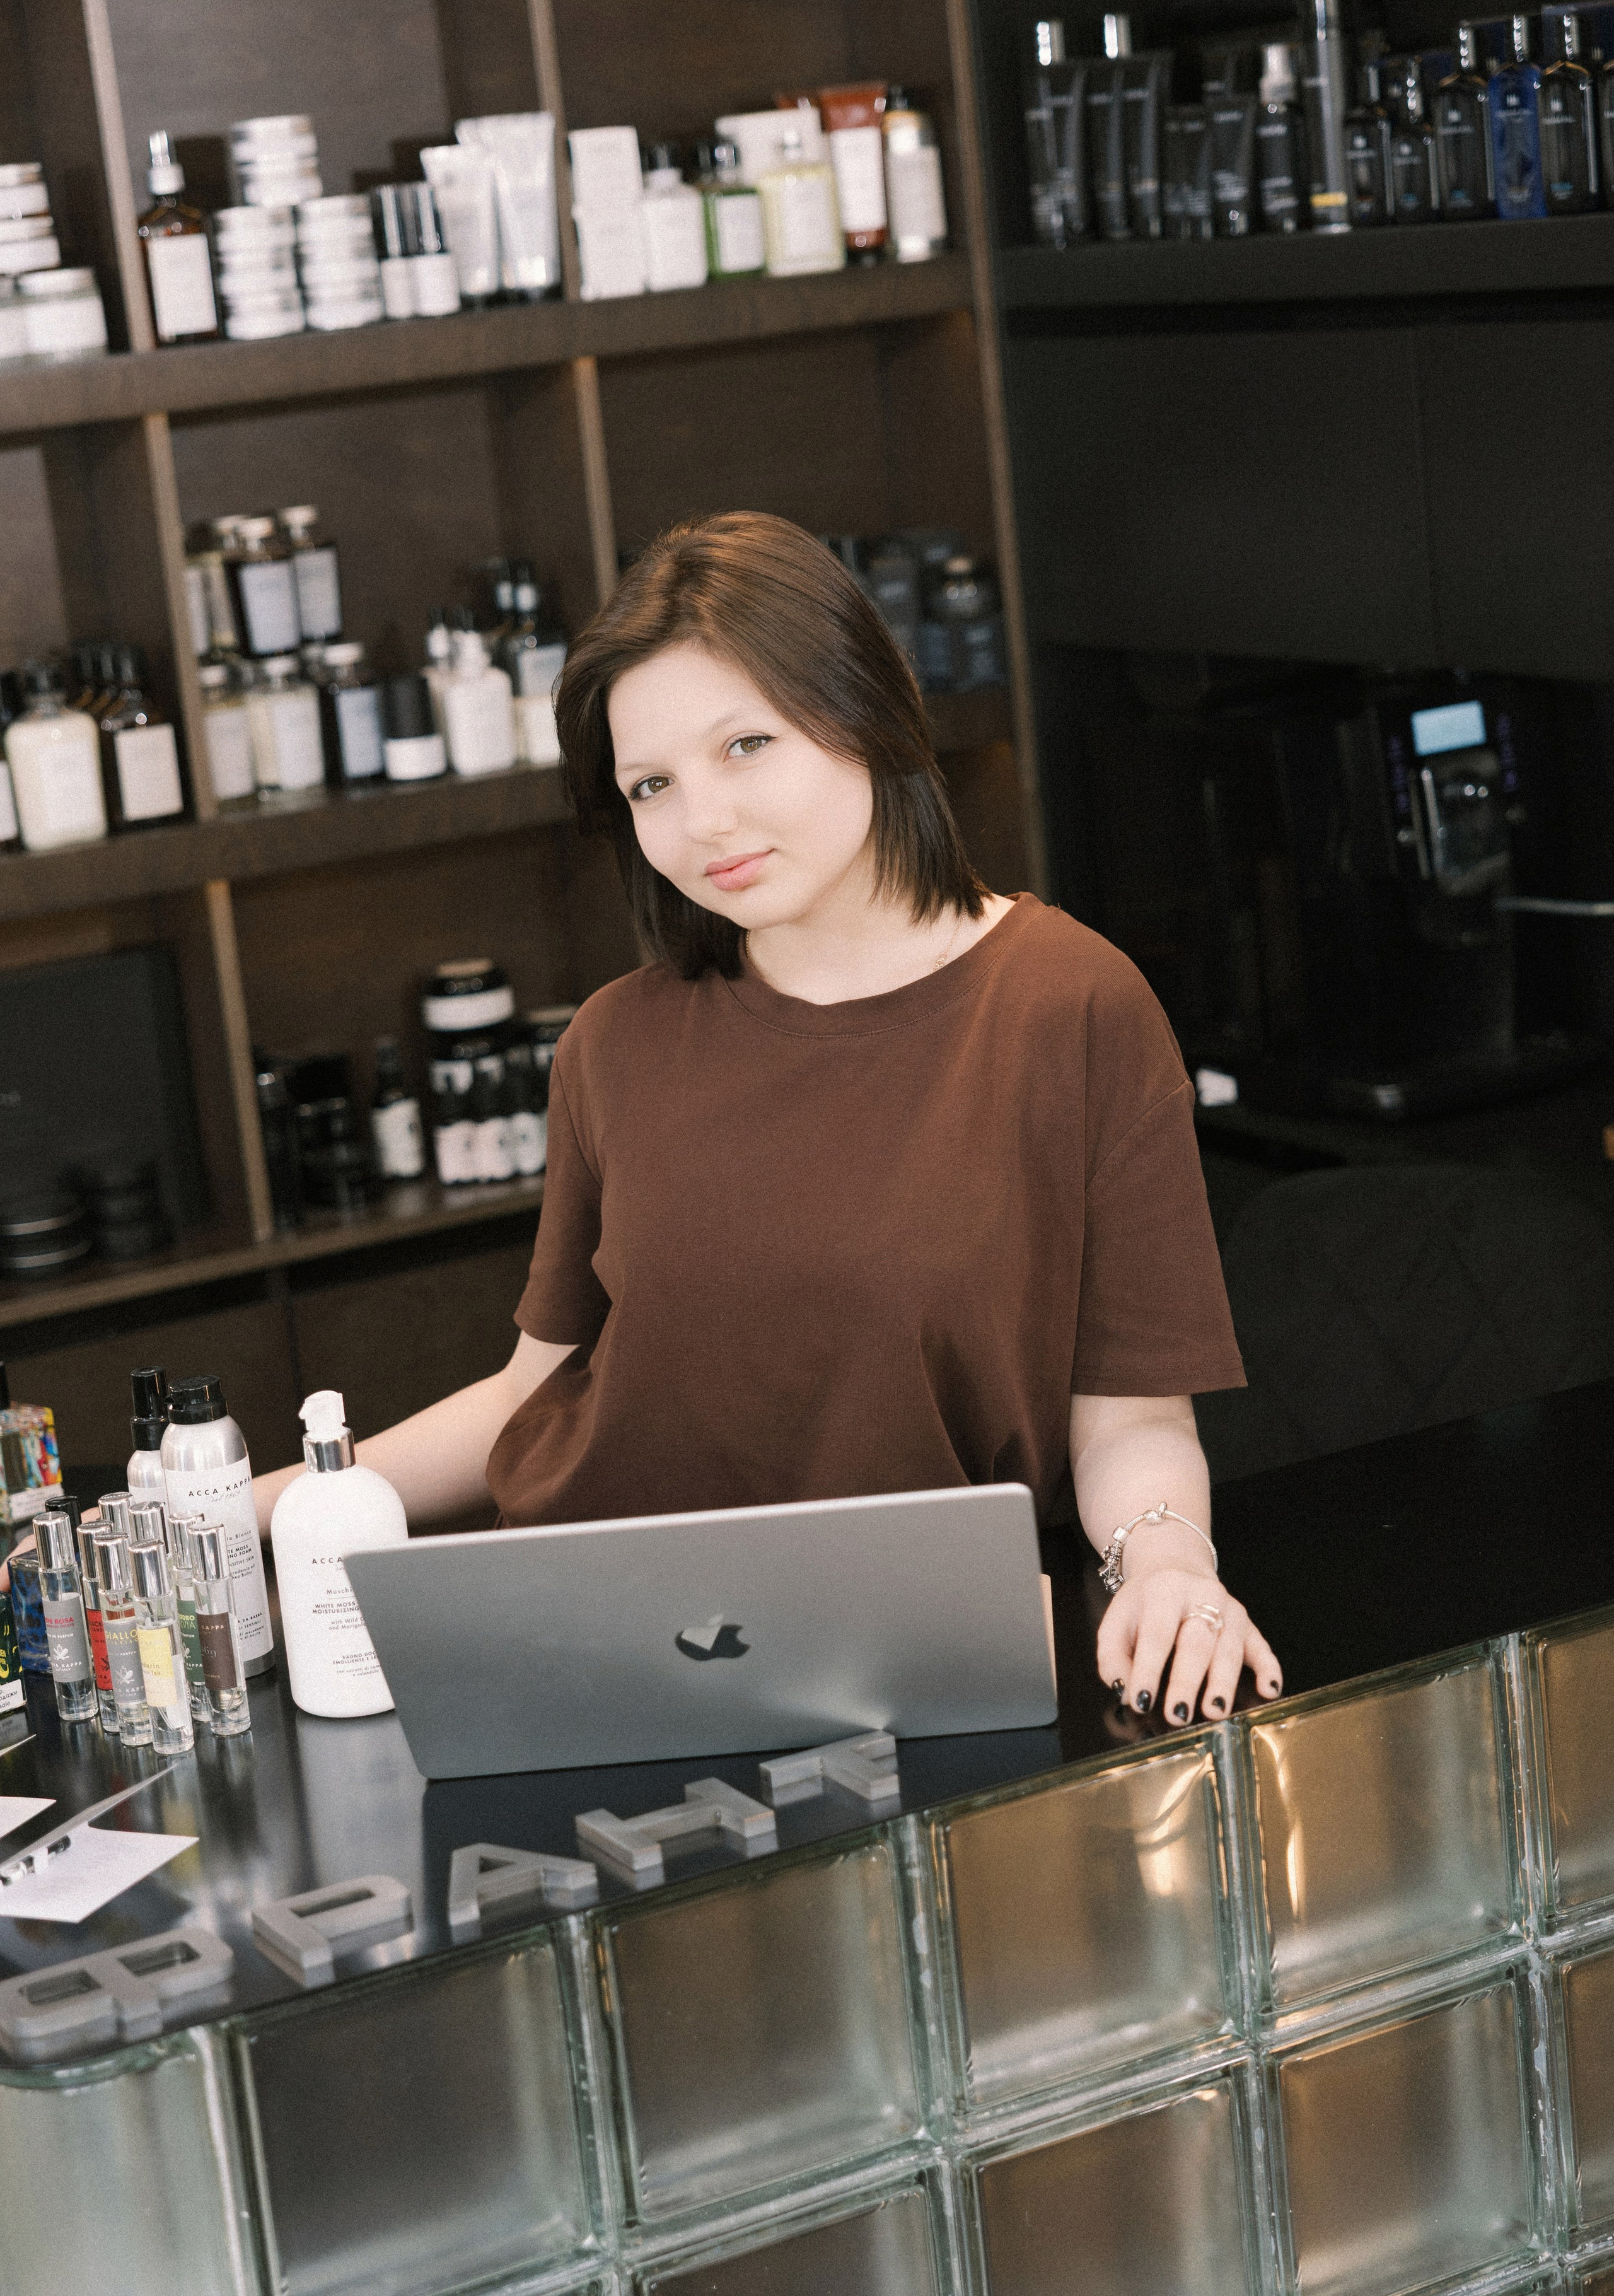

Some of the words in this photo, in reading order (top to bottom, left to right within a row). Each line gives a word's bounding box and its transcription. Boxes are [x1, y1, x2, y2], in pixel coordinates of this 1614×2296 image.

[189, 1488, 218, 1496] ACCA
[226, 1476, 251, 1491] KAPPA
[229, 1559, 245, 1567] NSITIVE
[327, 1587, 352, 1595] Muschi
[312, 1606, 360, 1614] MOISTURIZING
[0, 1691, 18, 1701] одажи
